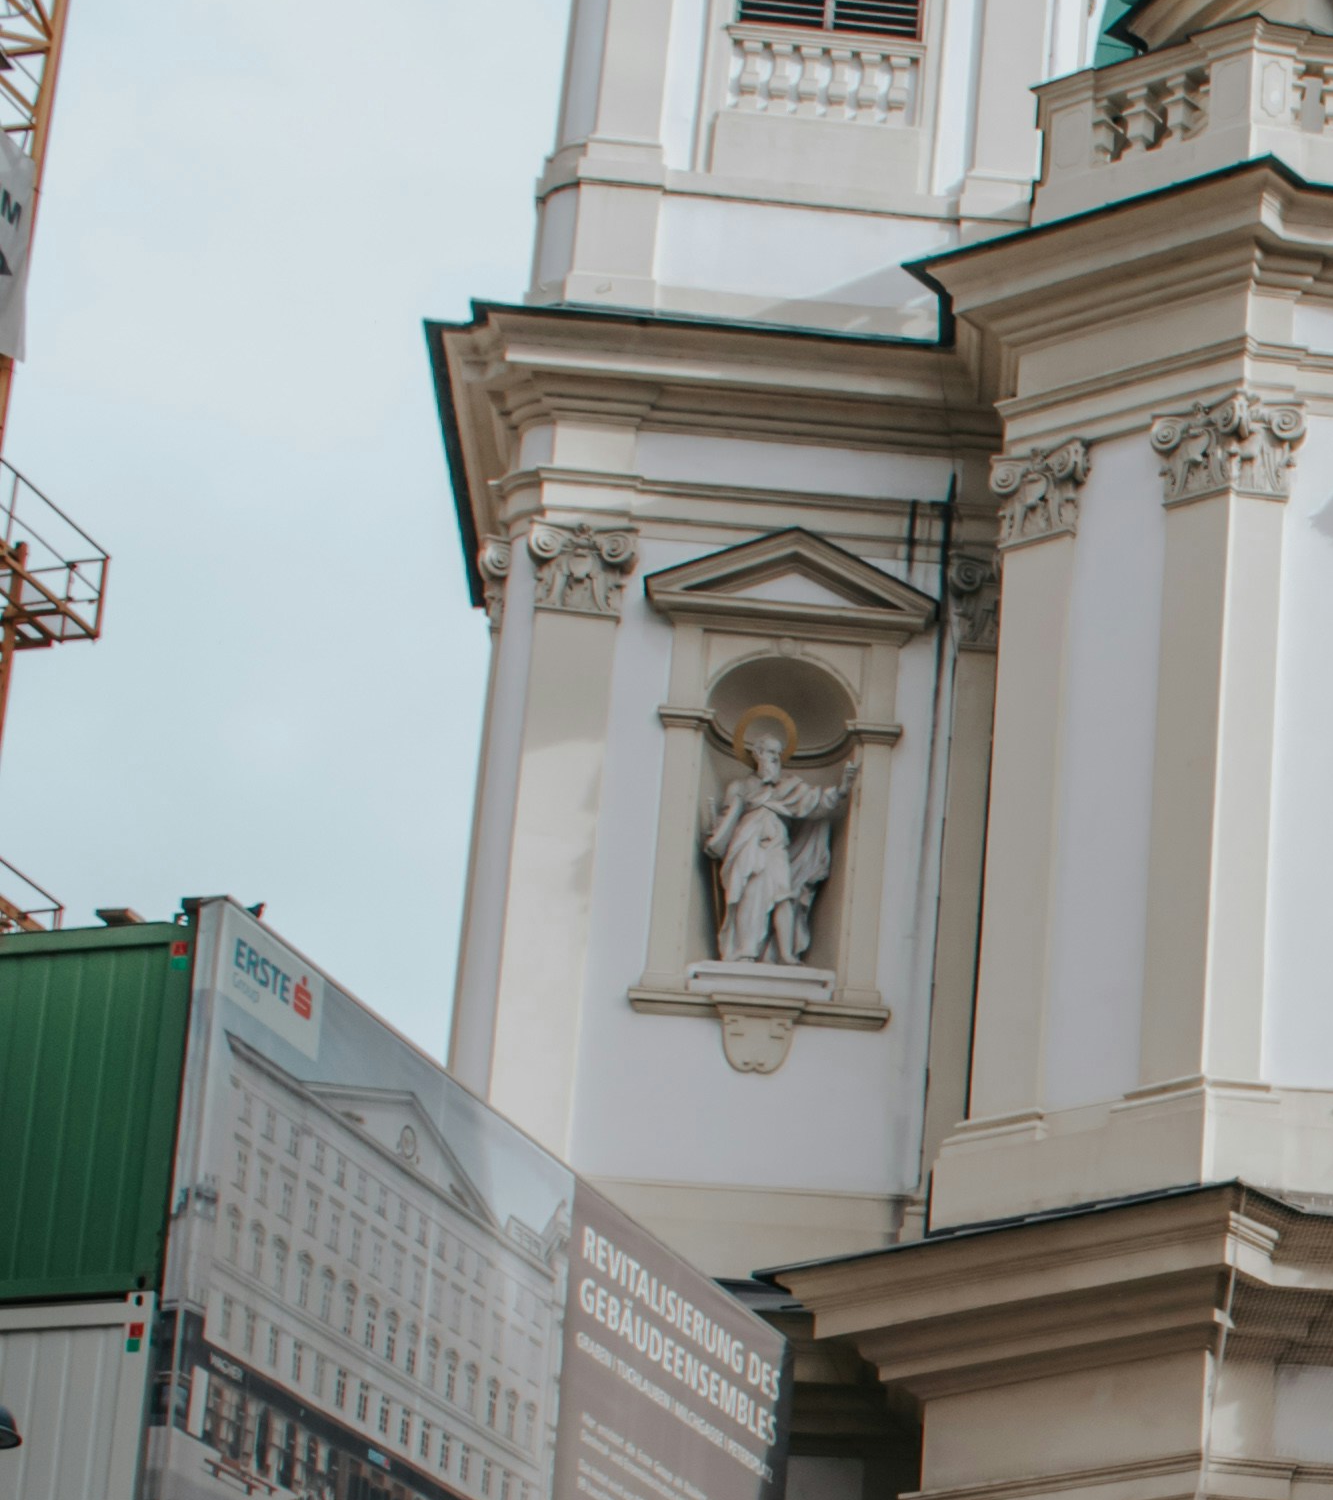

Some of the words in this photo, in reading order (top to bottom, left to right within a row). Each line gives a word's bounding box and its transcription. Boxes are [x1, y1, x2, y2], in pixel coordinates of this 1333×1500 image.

[234, 937, 291, 1006] ERSTE
[580, 1277, 778, 1447] GEBÄUDEENSEMBLES
[582, 1225, 744, 1374] REVITALISIERUNG
[748, 1351, 781, 1401] DES
